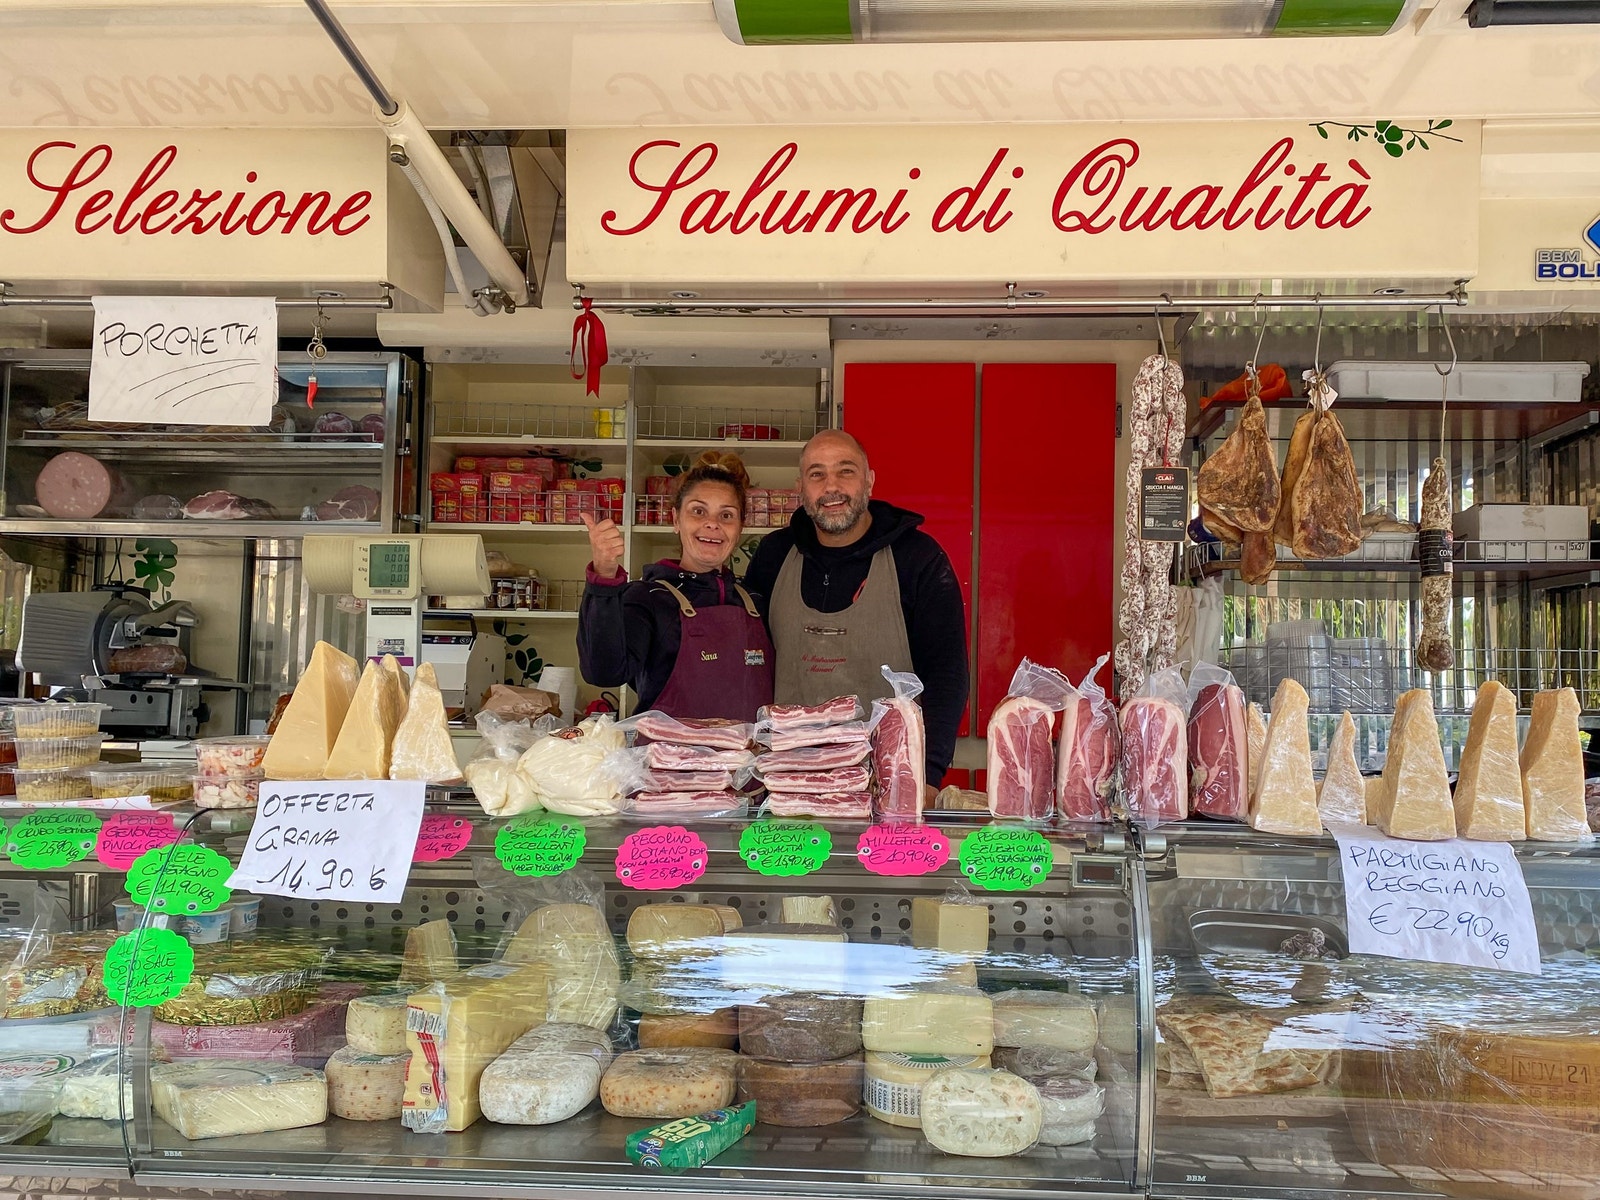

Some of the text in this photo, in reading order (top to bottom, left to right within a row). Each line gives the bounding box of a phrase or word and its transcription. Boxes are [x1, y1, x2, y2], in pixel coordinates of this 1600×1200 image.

[1, 141, 372, 236] Selezione
[600, 137, 1372, 236] Salumi di Qualità
[1538, 251, 1580, 262] BBM
[1538, 263, 1600, 278] BOL
[99, 322, 259, 357] PORCHETTA
[701, 650, 718, 661] Sara
[262, 793, 375, 817] OFFERTA
[119, 814, 168, 825] PESTO
[105, 826, 178, 839] GENOVESE
[880, 825, 922, 834] MIELE
[102, 839, 142, 851] PINOLI
[255, 825, 340, 851] GRANA
[632, 831, 692, 846] PECORINO
[17, 841, 36, 857] €
[632, 846, 688, 860] ROMANO
[868, 849, 886, 865] €
[761, 856, 774, 868] €
[1350, 846, 1499, 873] PARMIGIANO
[631, 868, 645, 882] €
[975, 866, 988, 881] €
[136, 879, 152, 895] €
[1366, 871, 1505, 897] REGGIANO
[1368, 902, 1402, 935] €
[1406, 906, 1493, 937] 22,90
[143, 951, 176, 970] SALE
[1518, 1060, 1588, 1084] NOV 21
[661, 1117, 711, 1138] 60
[649, 1128, 686, 1144] MESI
[1186, 1174, 1207, 1182] BBM
